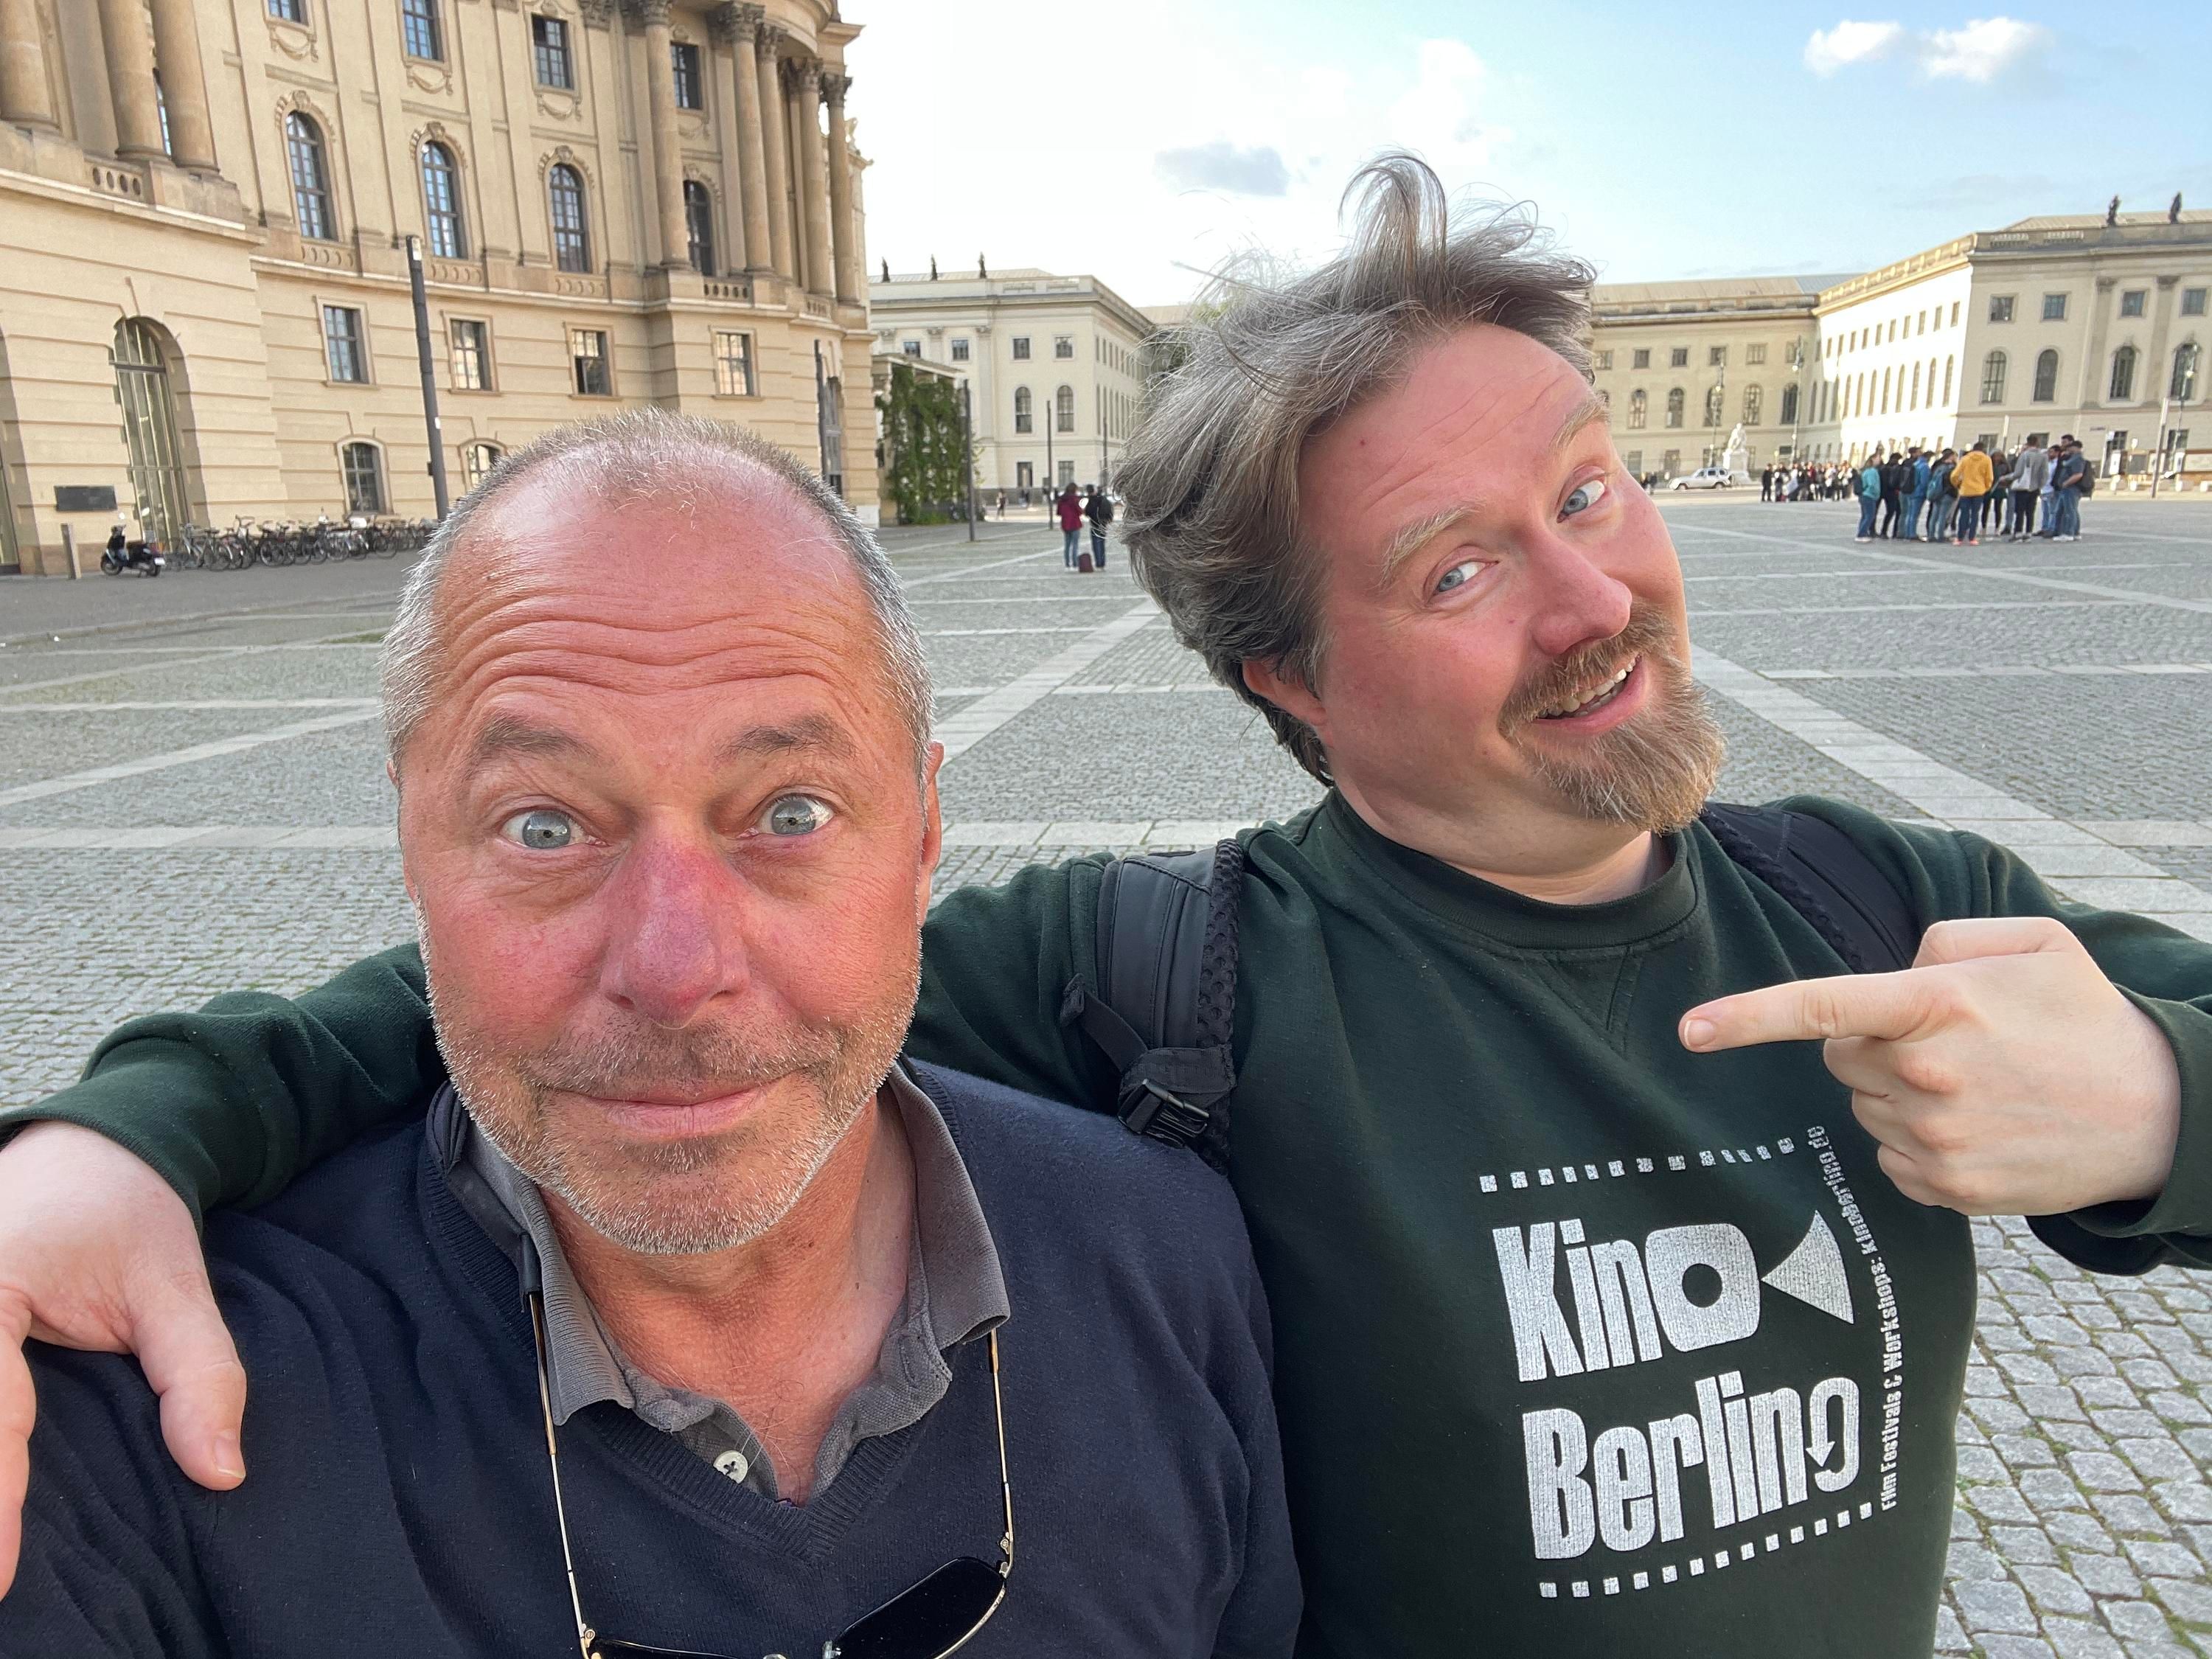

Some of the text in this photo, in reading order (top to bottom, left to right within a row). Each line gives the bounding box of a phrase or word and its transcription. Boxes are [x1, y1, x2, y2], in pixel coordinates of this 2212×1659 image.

[1492, 1218, 1761, 1382] Kino
[1871, 1256, 1903, 1373] Workshops:
[1880, 1390, 1902, 1473] Festivals
[1880, 1472, 1898, 1511] Film
